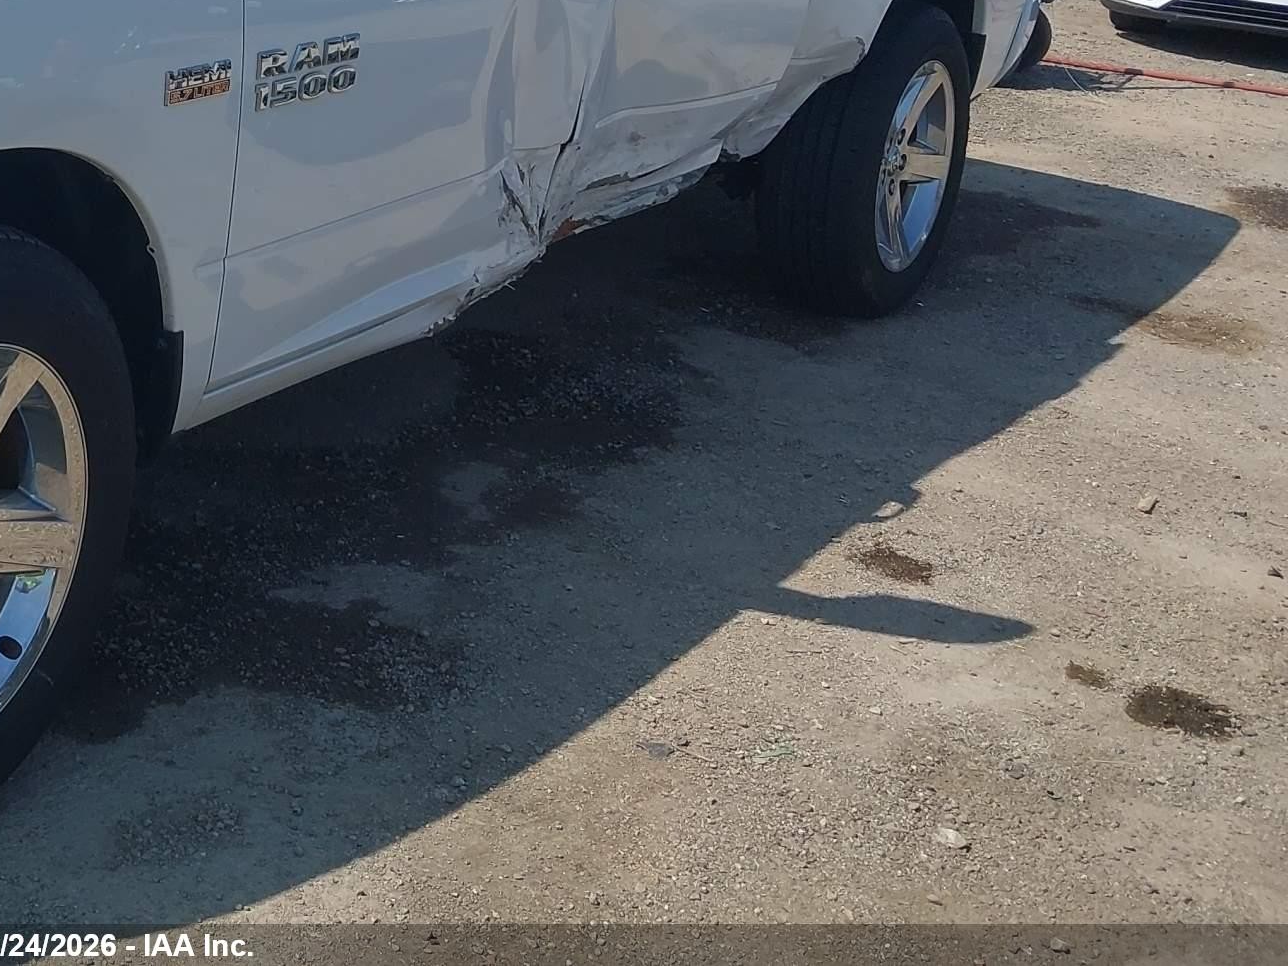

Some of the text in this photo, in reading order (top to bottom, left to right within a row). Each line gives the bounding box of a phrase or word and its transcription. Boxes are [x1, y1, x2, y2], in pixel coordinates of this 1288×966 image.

[167, 59, 232, 89] HEMI
[257, 32, 361, 80] RAM
[169, 80, 231, 105] 5.7 LITER
[255, 65, 357, 112] 1500
